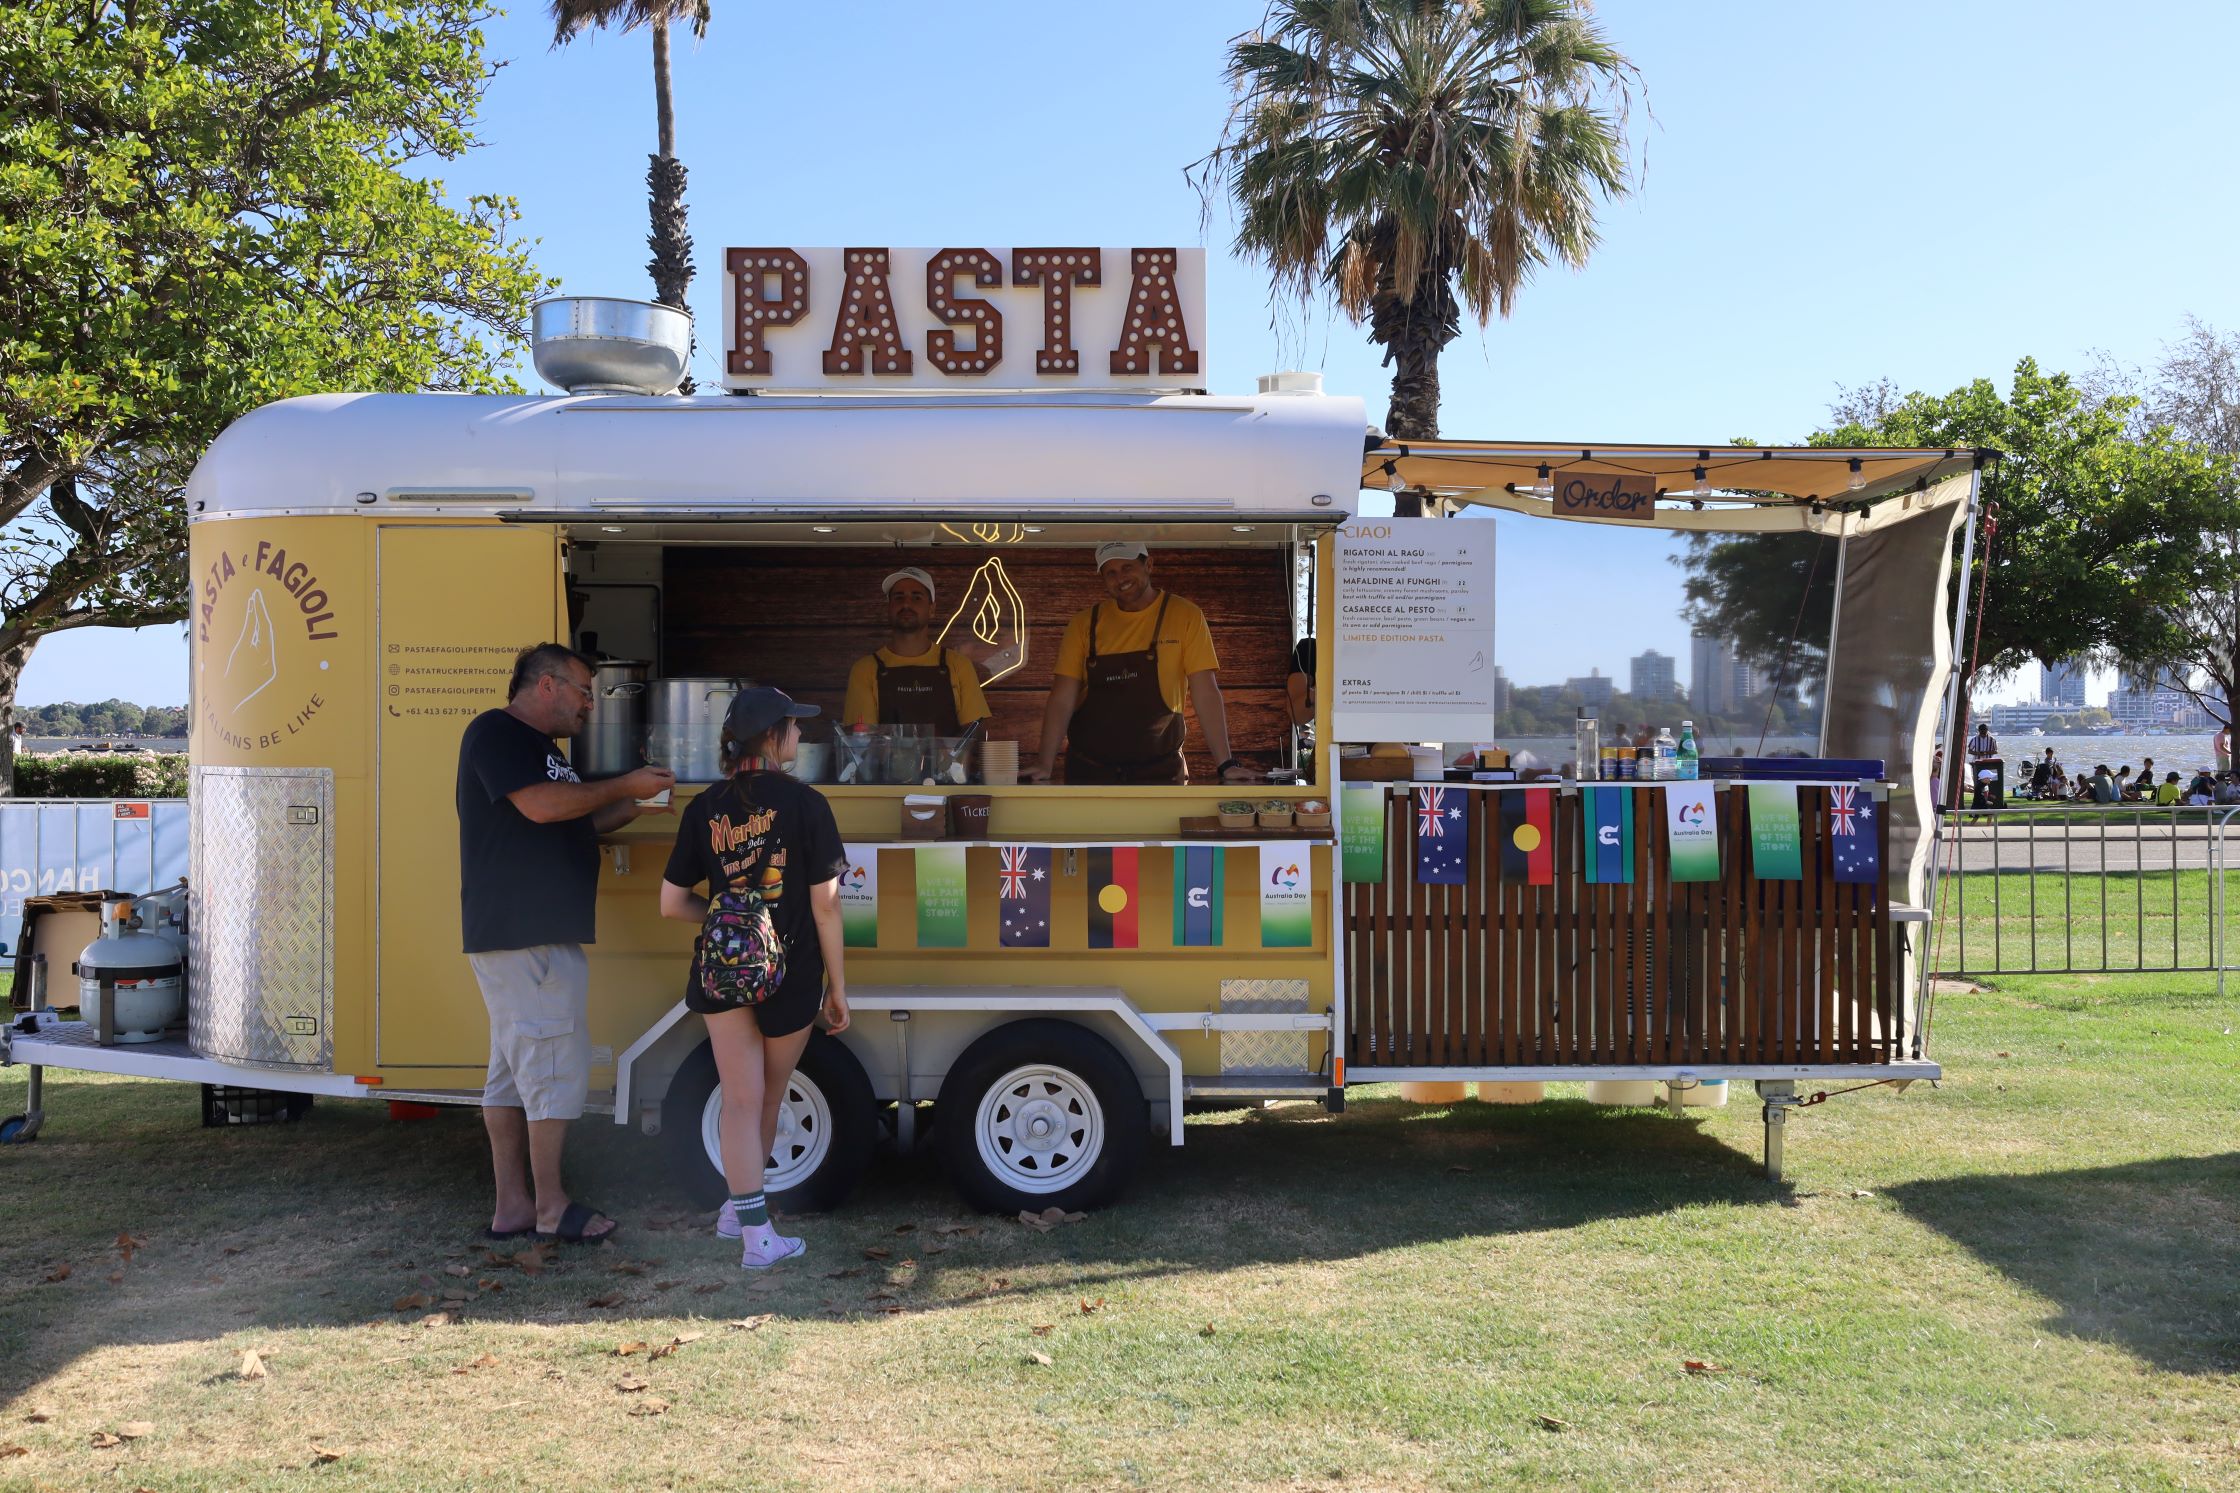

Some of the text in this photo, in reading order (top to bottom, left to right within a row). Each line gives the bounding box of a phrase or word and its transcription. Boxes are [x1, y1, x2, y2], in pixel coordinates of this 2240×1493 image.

[726, 247, 1199, 376] PASTA
[1562, 478, 1648, 512] Order
[1343, 526, 1392, 538] CIAO!
[1343, 549, 1385, 557] RIGATONI
[1387, 549, 1398, 557] AL
[1407, 578, 1441, 586] FUNGHI
[200, 551, 236, 643] PASTA
[255, 540, 338, 640] FAGIOLI
[1342, 605, 1392, 613] CASARECCE
[1408, 606, 1435, 614] PESTO
[405, 687, 496, 695] PASTAEFAGIOLIPERTH
[202, 693, 325, 750] ITALIANS BE LIKE
[1754, 824, 1798, 832] ALL PART
[1360, 835, 1376, 844] THE
[1760, 834, 1793, 842] OF THE
[861, 894, 873, 902] Day
[941, 898, 960, 907] THE
